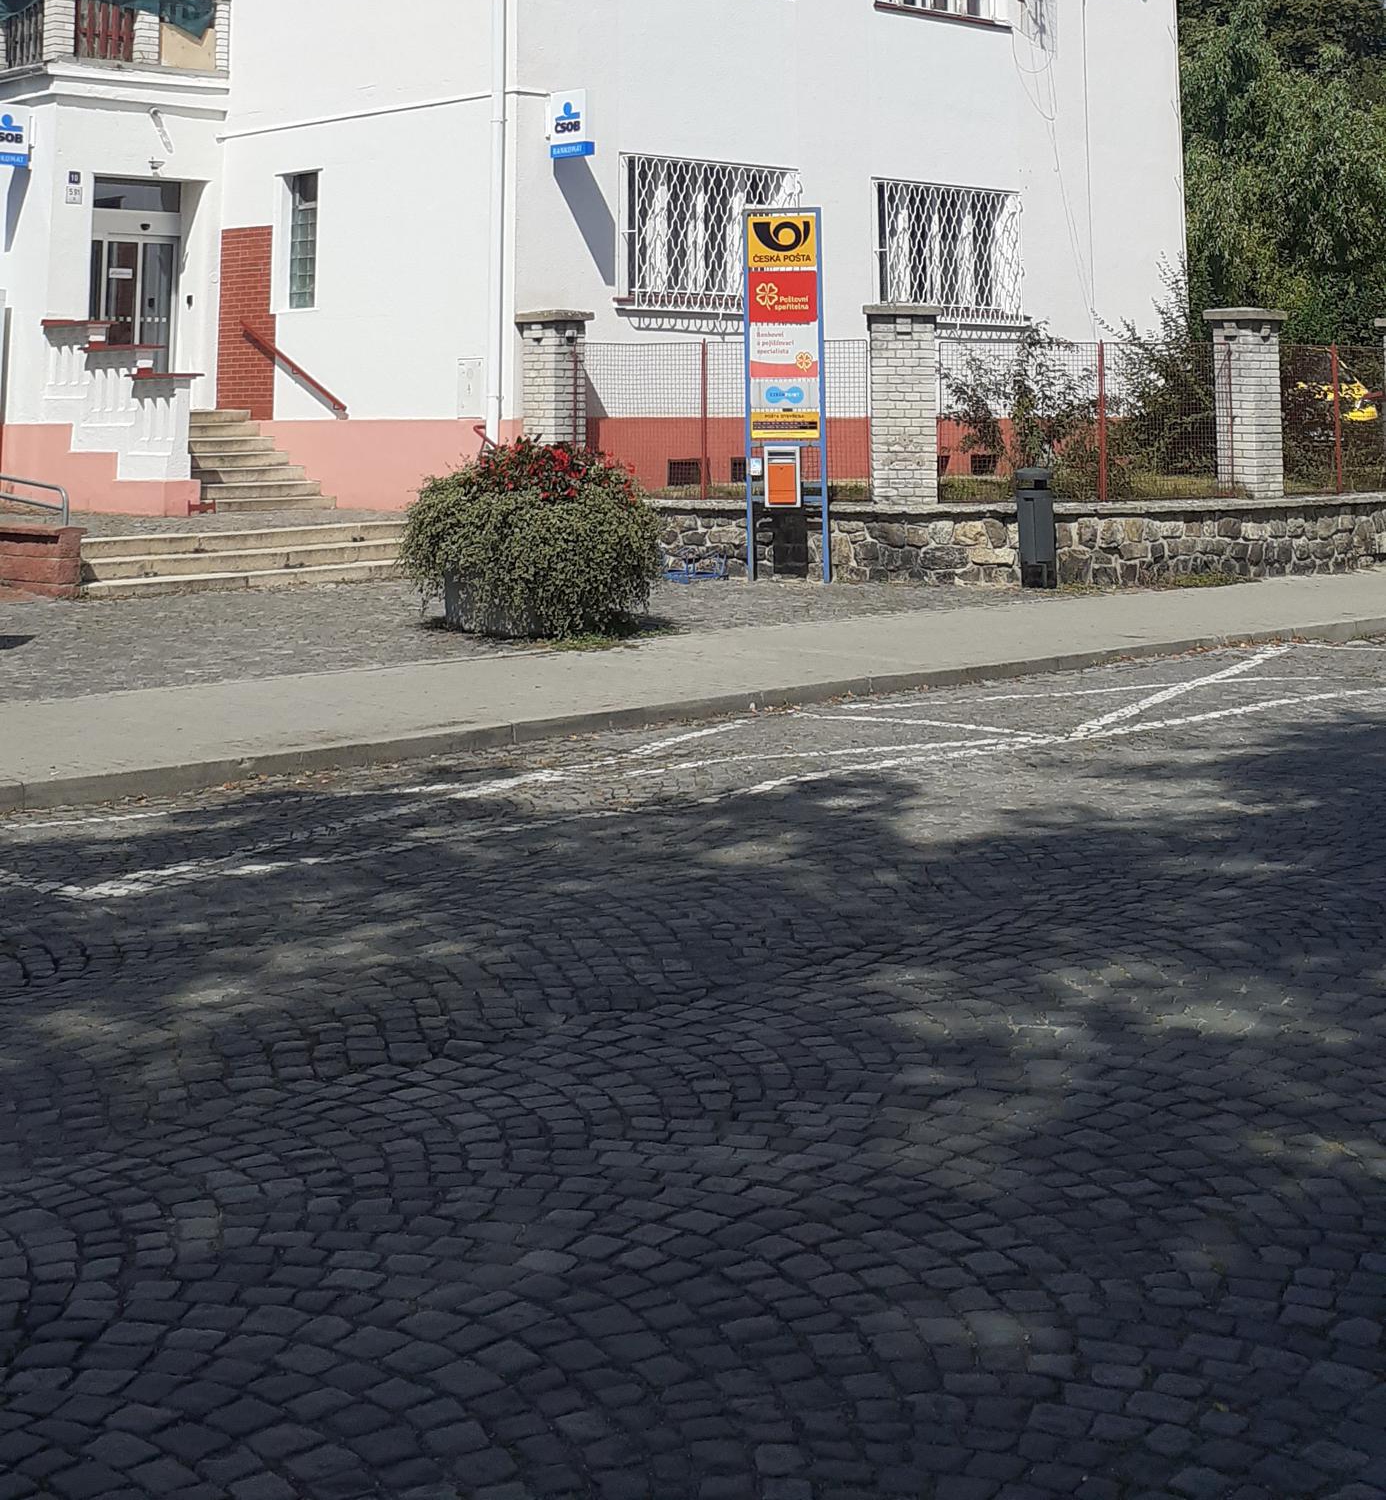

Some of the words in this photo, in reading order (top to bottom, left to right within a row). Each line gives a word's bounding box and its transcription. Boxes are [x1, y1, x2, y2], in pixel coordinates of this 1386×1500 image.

[555, 120, 580, 133] ČSOB
[0, 132, 23, 143] SOB
[752, 253, 781, 263] ČESKÁ
[783, 252, 811, 262] POŠTA
[779, 295, 809, 303] Poštovní
[774, 303, 809, 311] spořitelna
